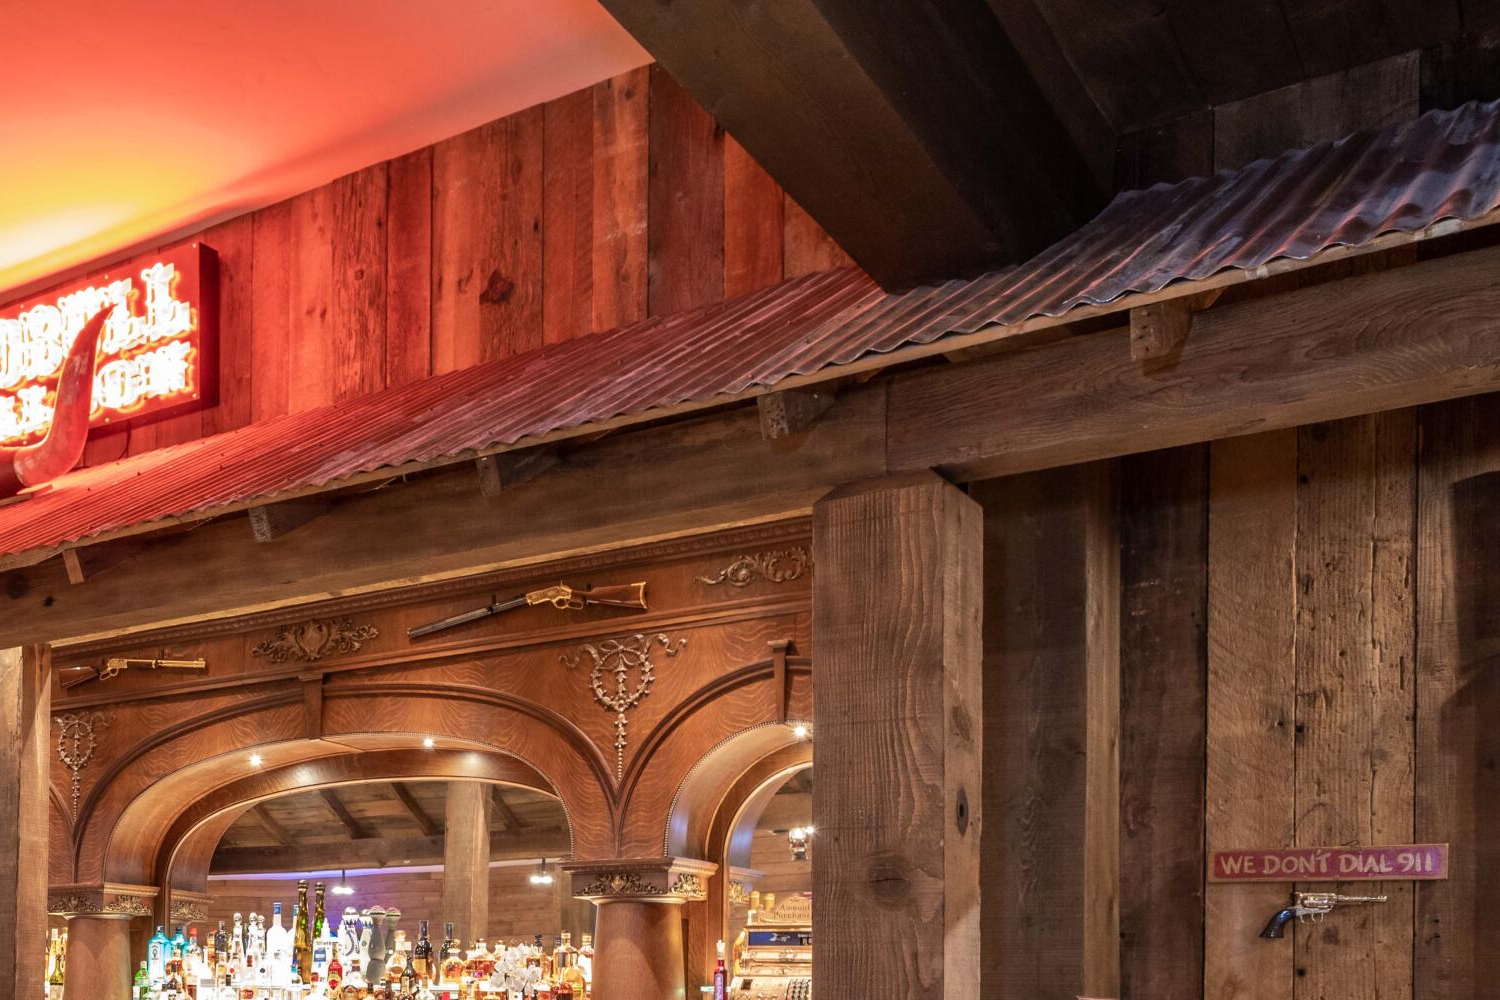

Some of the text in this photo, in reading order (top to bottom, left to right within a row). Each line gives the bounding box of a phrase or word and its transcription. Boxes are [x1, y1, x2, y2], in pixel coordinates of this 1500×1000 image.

[1220, 849, 1433, 875] WE DON'T DIAL 911
